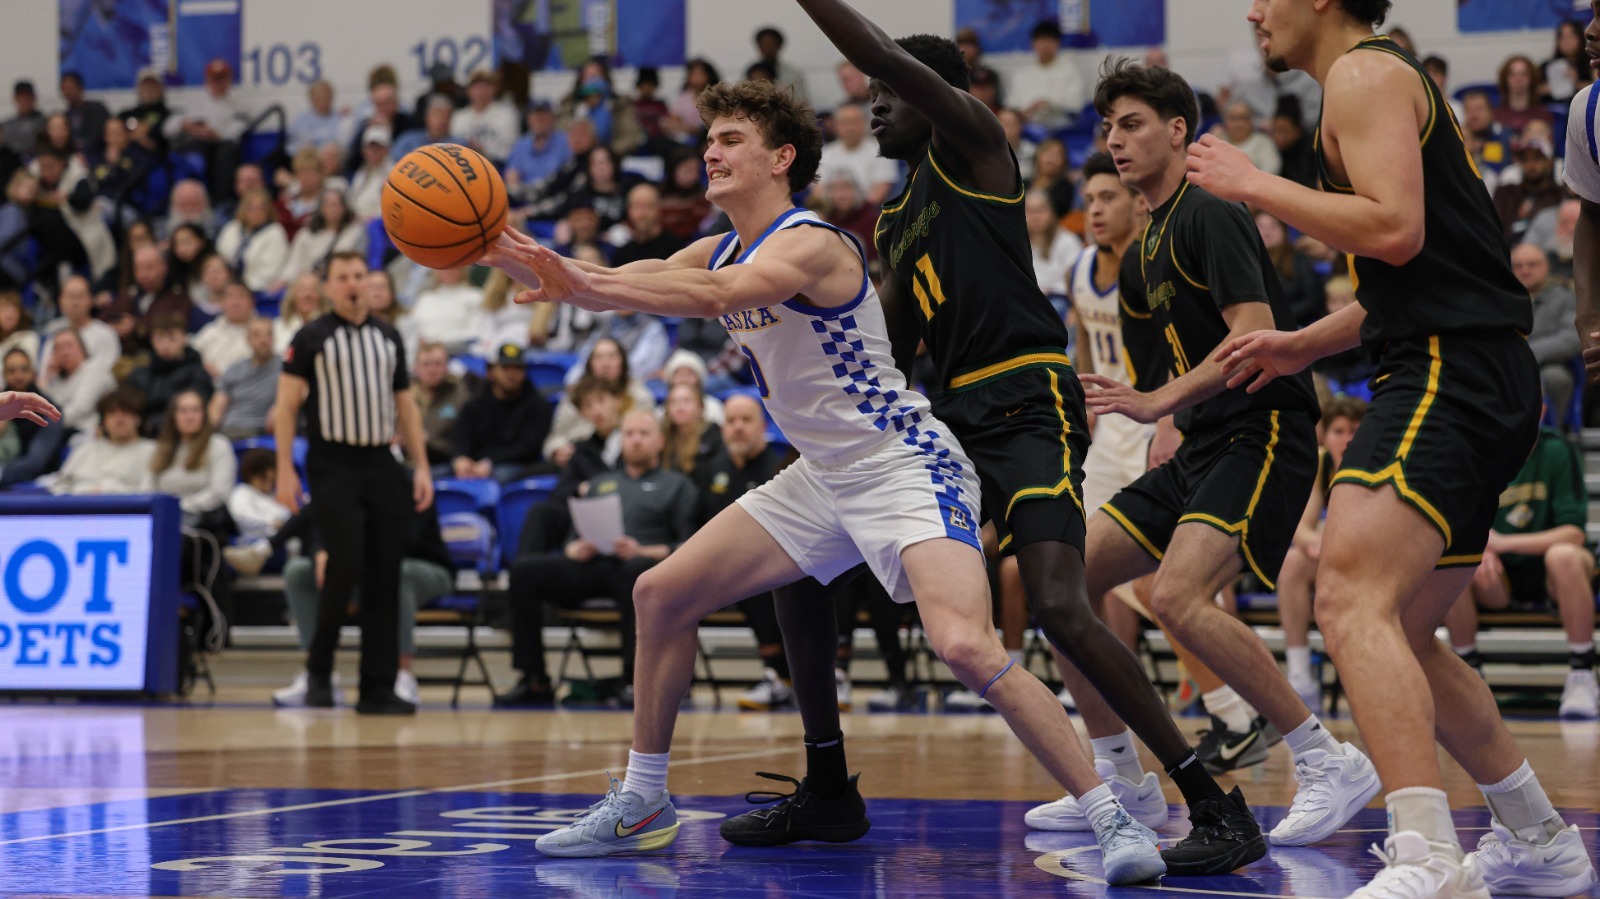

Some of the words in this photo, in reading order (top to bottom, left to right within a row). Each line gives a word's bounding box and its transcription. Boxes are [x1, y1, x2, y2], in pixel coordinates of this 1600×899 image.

[243, 42, 322, 86] 103
[912, 253, 947, 322] 11
[722, 306, 781, 332] ASKA
